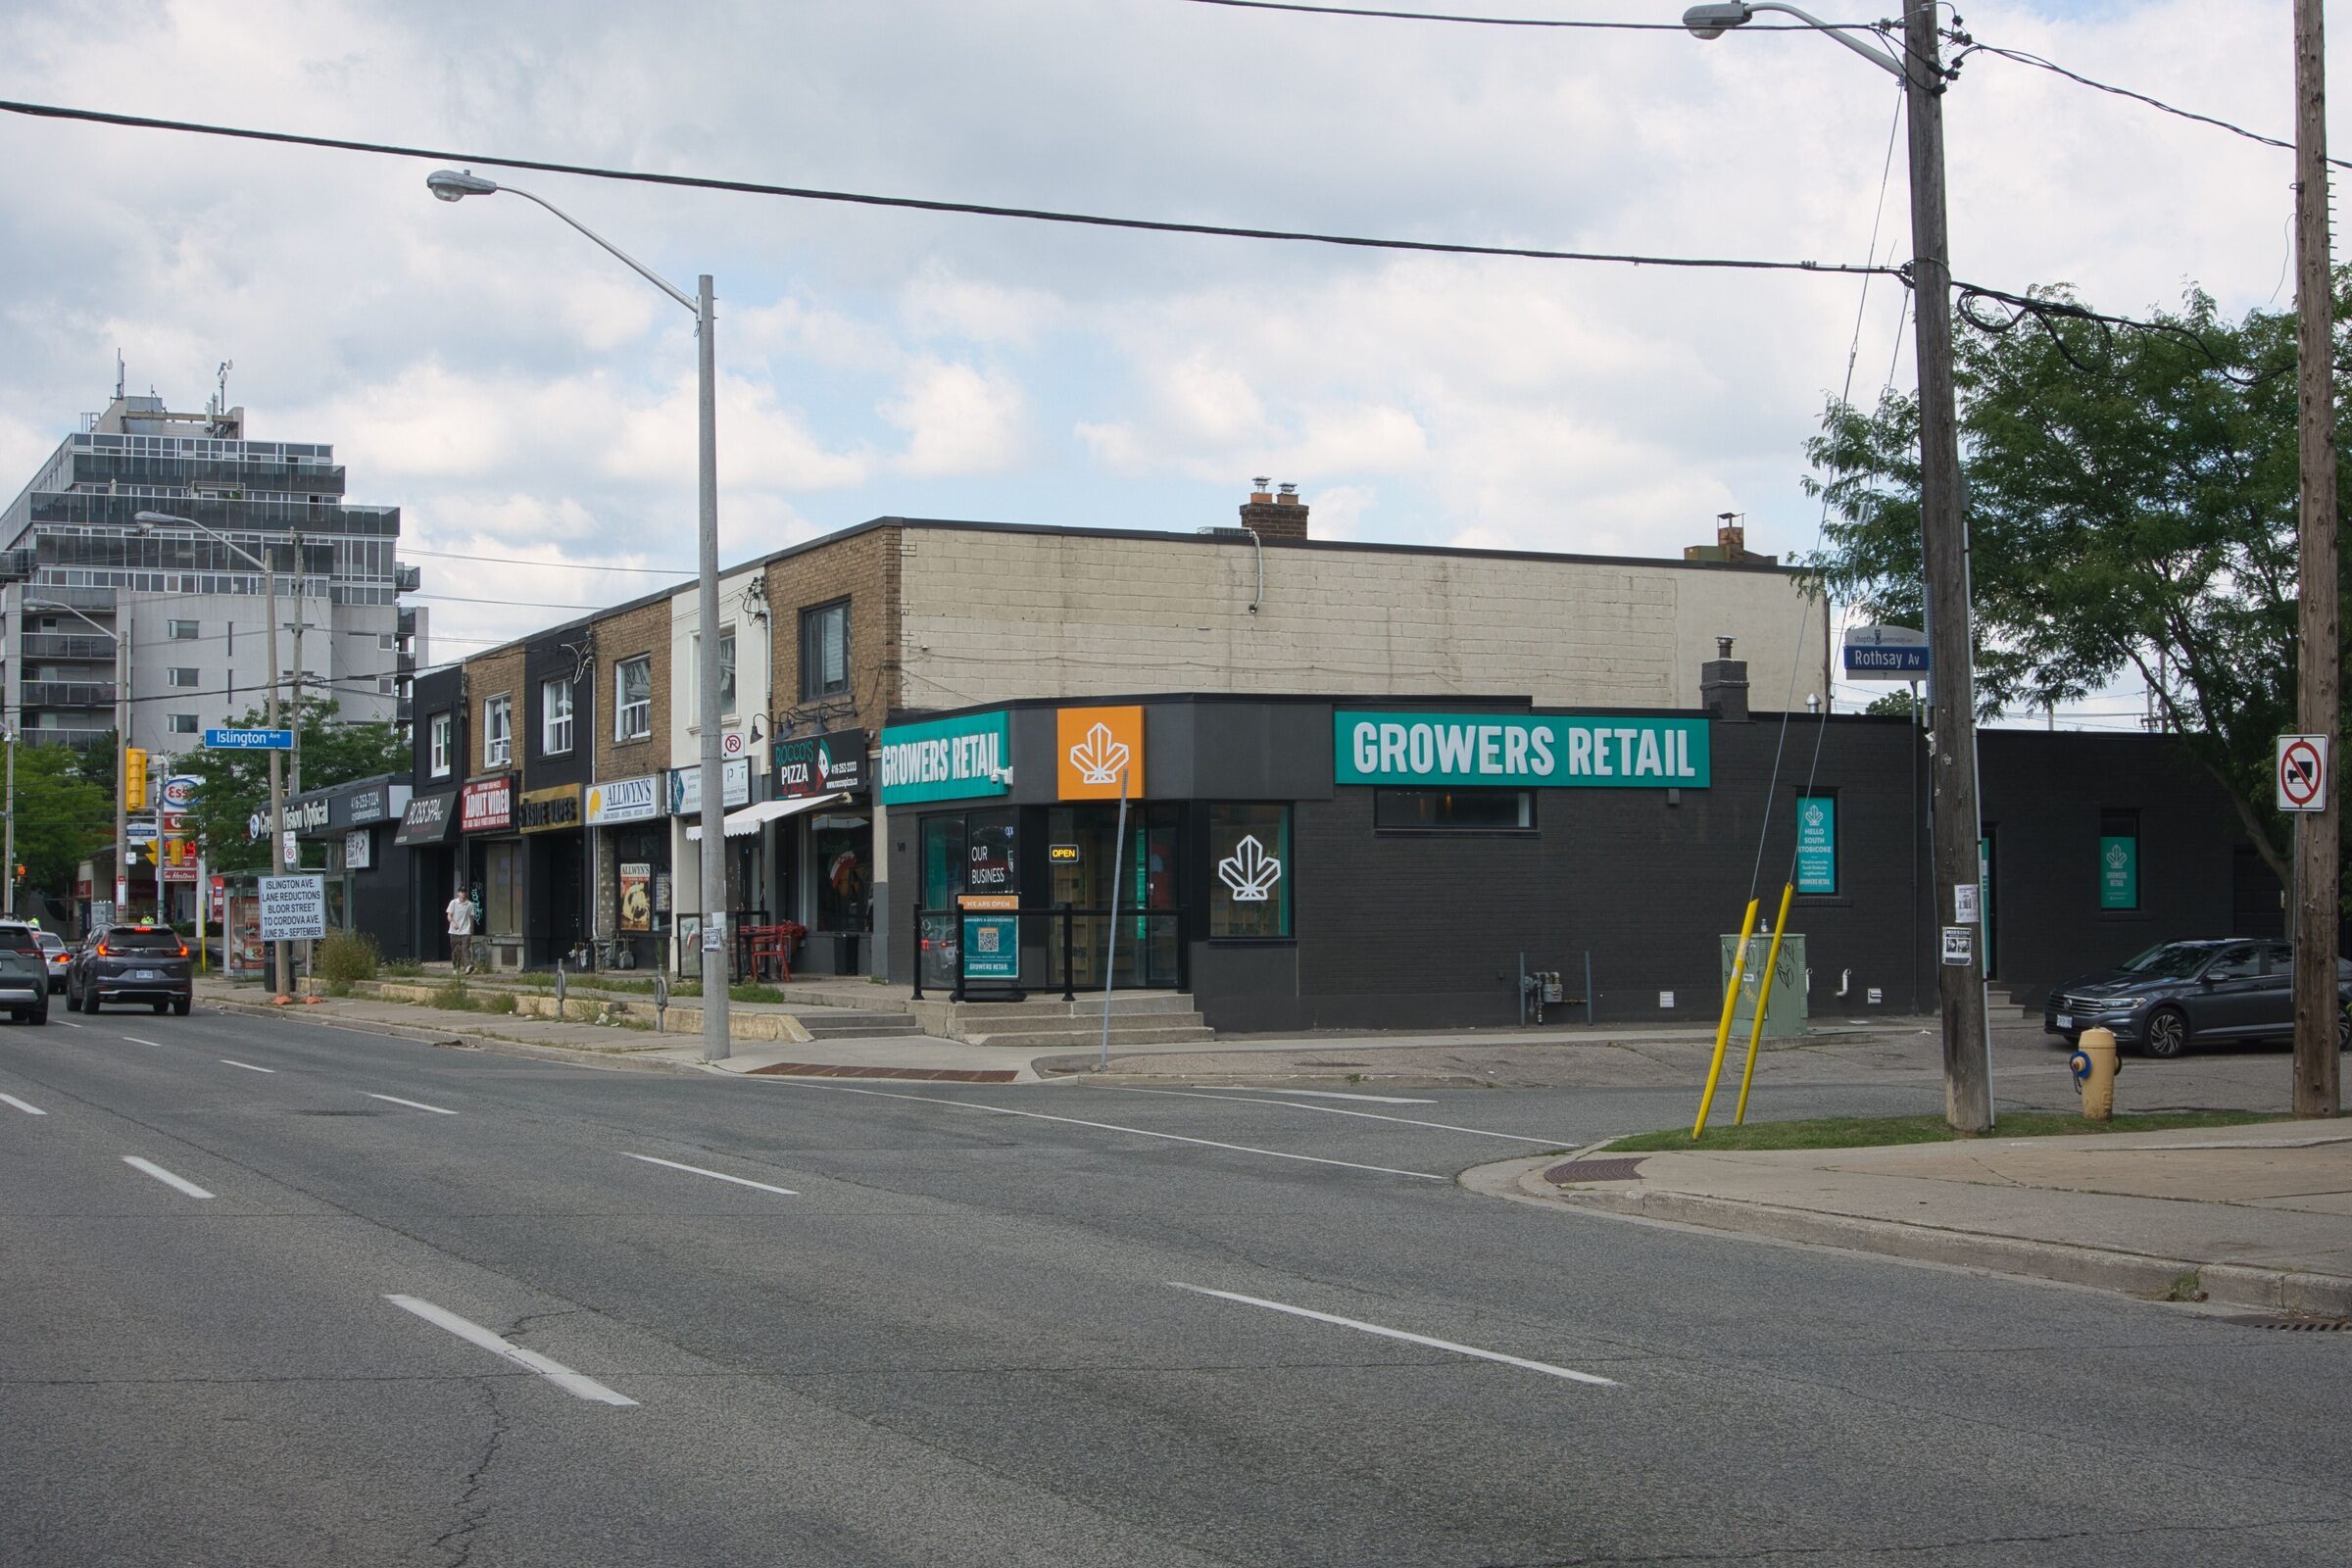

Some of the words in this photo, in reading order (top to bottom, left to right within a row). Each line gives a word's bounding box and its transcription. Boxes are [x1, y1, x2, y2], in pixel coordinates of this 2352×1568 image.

[1855, 650, 1903, 669] Rothsay
[1908, 653, 1920, 665] Av
[217, 730, 267, 747] Islington
[775, 740, 814, 768] ROCCO'S
[1353, 721, 1555, 776] GROWERS
[1568, 727, 1695, 777] RETAIL
[882, 738, 949, 787] GROWERS
[952, 732, 999, 780] RETAIL
[781, 763, 808, 785] PIZZA
[169, 786, 191, 799] Ess
[607, 779, 652, 807] ALLWYN'S
[466, 793, 487, 818] ADULT
[488, 788, 510, 815] VIDEO
[550, 797, 575, 823] VAPES
[282, 806, 302, 830] Vision
[304, 799, 328, 833] Optical
[407, 801, 429, 825] BOSS
[971, 846, 988, 861] OUR
[1052, 849, 1076, 858] OPEN
[622, 865, 650, 875] ALLWYN'S
[971, 867, 1004, 884] BUSINESS
[266, 880, 300, 890] ISLINGTON
[301, 879, 315, 888] AVE.
[262, 892, 279, 902] LANE
[280, 891, 320, 901] REDUCTIONS
[268, 905, 290, 913] BLOOR
[291, 903, 316, 912] STREET
[264, 917, 272, 926] TO
[274, 915, 305, 925] CORDOVA
[306, 914, 320, 924] AVE.
[264, 929, 277, 938] JUNE
[289, 927, 321, 937] SEPTEMBER
